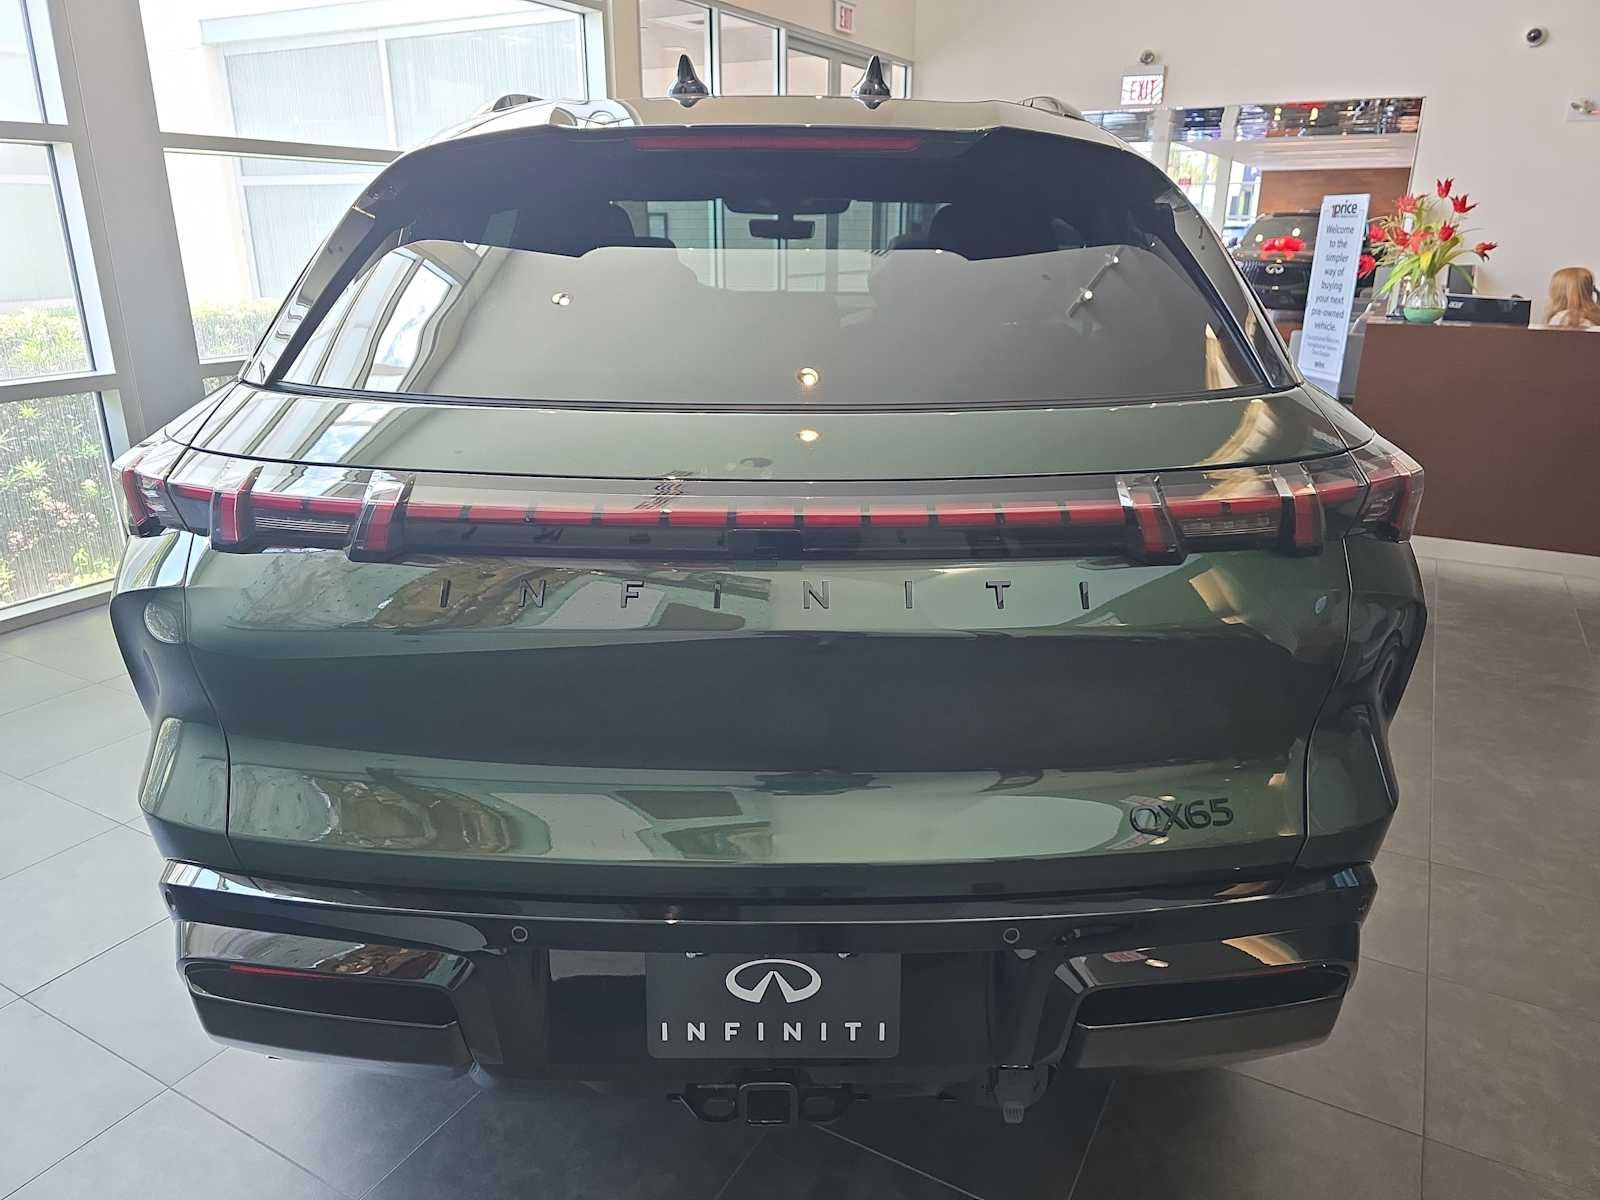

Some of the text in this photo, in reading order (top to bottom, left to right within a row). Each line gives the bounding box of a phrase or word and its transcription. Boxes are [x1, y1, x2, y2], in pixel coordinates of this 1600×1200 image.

[1130, 79, 1156, 101] EXIT
[1326, 224, 1355, 234] Welcome
[1329, 240, 1348, 248] to the
[1325, 253, 1350, 264] simpler
[1324, 267, 1345, 278] way of
[1320, 280, 1344, 293] buying
[1315, 296, 1344, 305] your next
[1311, 308, 1345, 319] pre-owned
[439, 579, 1090, 610] INFINITI
[1130, 798, 1234, 837] QX65
[661, 1022, 886, 1041] INFINITI
